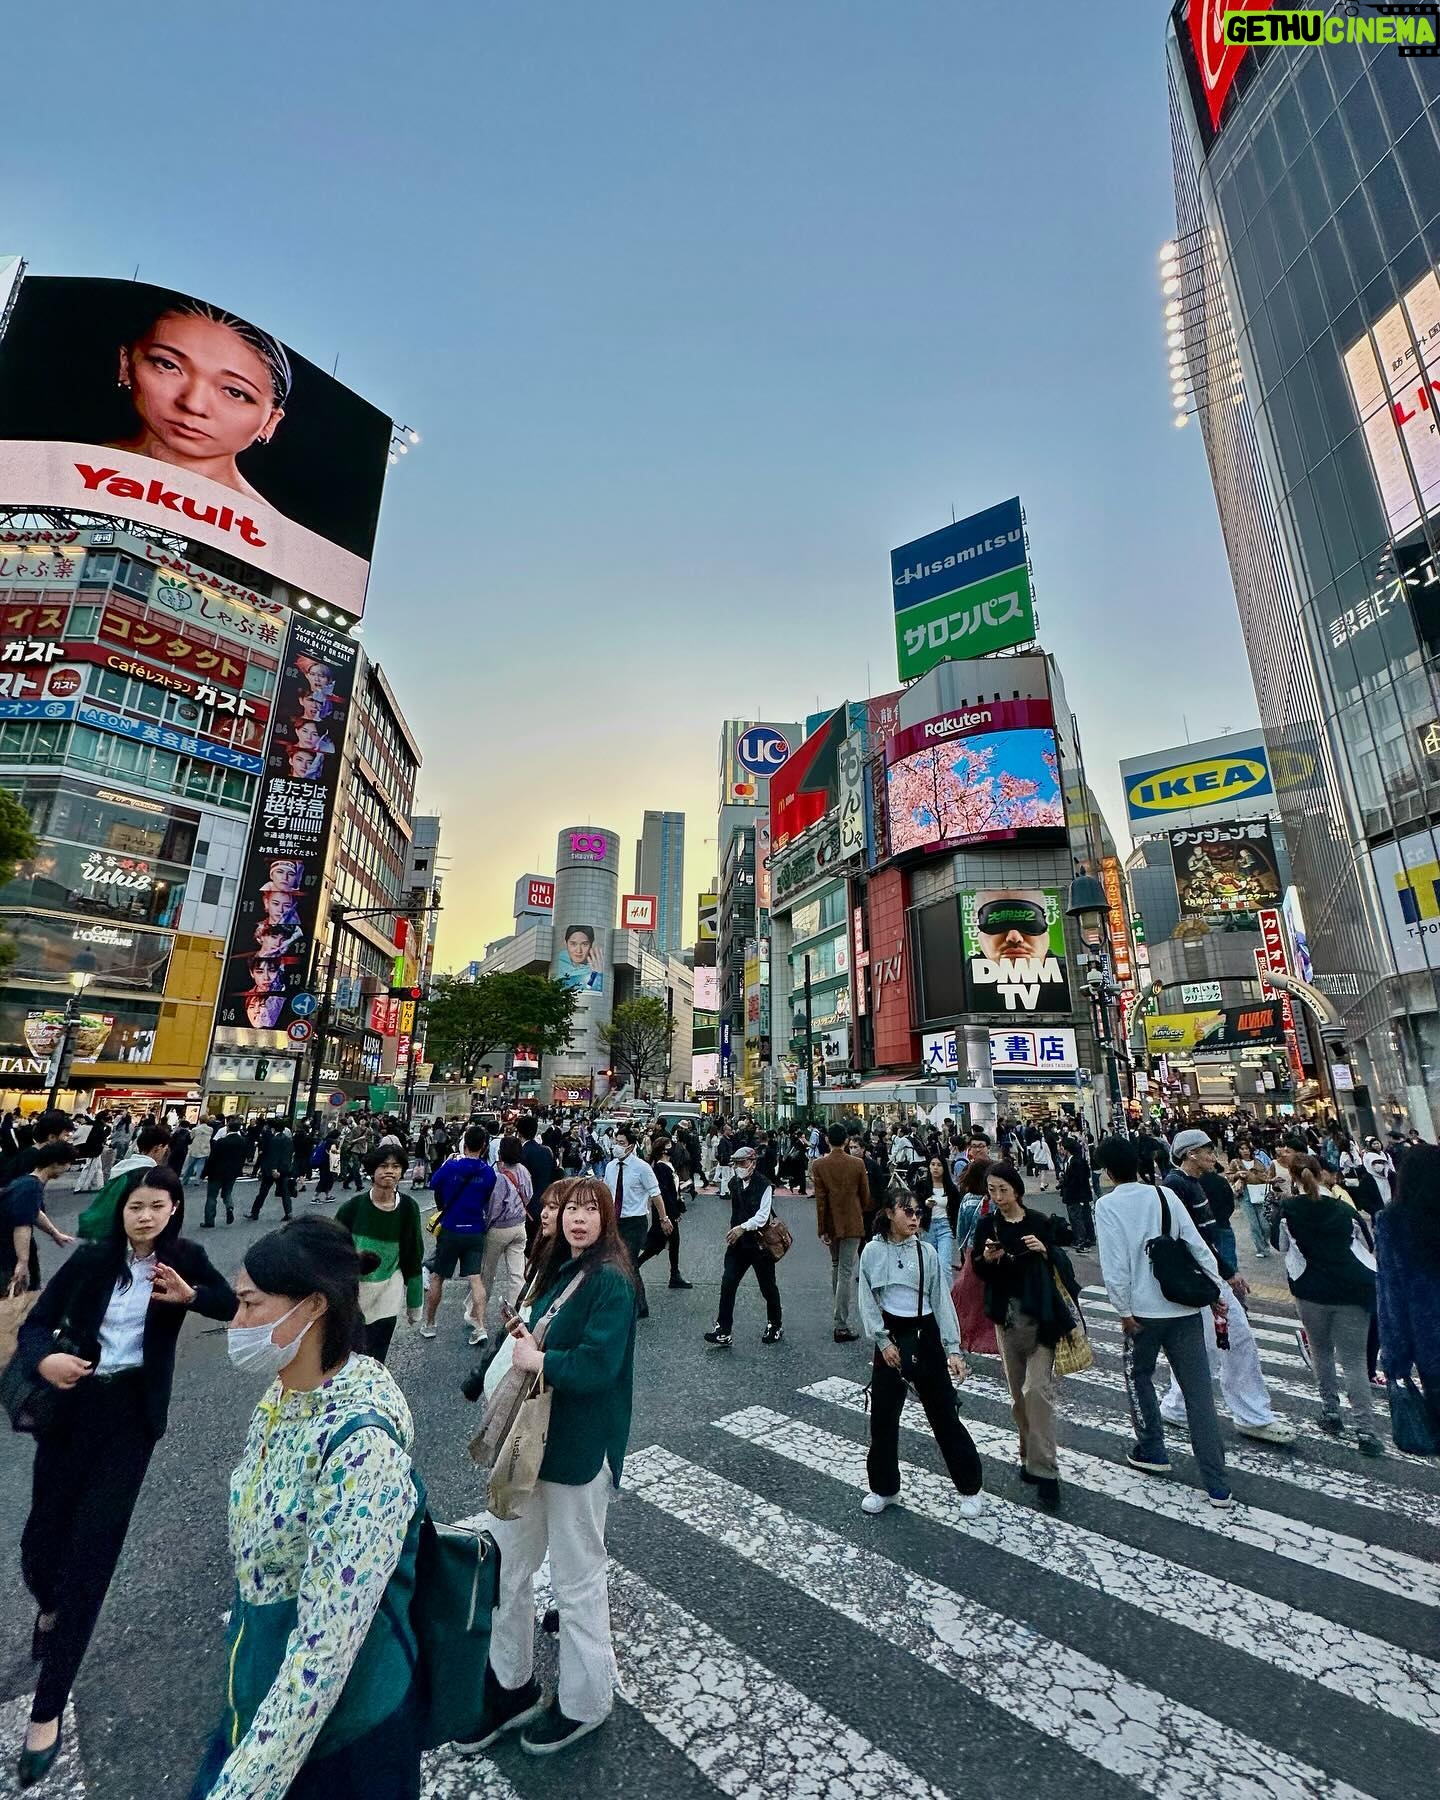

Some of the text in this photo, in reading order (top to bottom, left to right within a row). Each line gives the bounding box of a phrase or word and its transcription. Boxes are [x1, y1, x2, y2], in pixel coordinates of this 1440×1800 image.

[74, 463, 267, 547] Yakult
[0, 531, 80, 543] ぶバイキング
[895, 528, 1021, 585] Hisamitsu
[200, 597, 279, 645] しゃぶ葉
[903, 591, 1023, 656] サロンパス
[1, 641, 64, 662] ガスト
[102, 613, 241, 678] コンタクト
[51, 681, 78, 690] ガスト
[194, 684, 256, 717] ガスト
[87, 710, 131, 731] AEON
[924, 710, 992, 738] Rakuten
[743, 739, 786, 764] UC
[269, 777, 329, 799] 僕たちは
[1140, 765, 1255, 803] IKEA
[264, 794, 326, 820] 超特急
[569, 833, 607, 862] 109
[1172, 823, 1267, 847] ダンジョン飯
[531, 884, 551, 894] UNI
[531, 895, 551, 905] QLO
[294, 942, 306, 954] 12
[289, 974, 301, 985] 13
[971, 957, 1063, 983] DMM
[996, 984, 1040, 1010] TV
[1192, 984, 1219, 993] れいわ
[363, 1034, 380, 1053] LUSH
